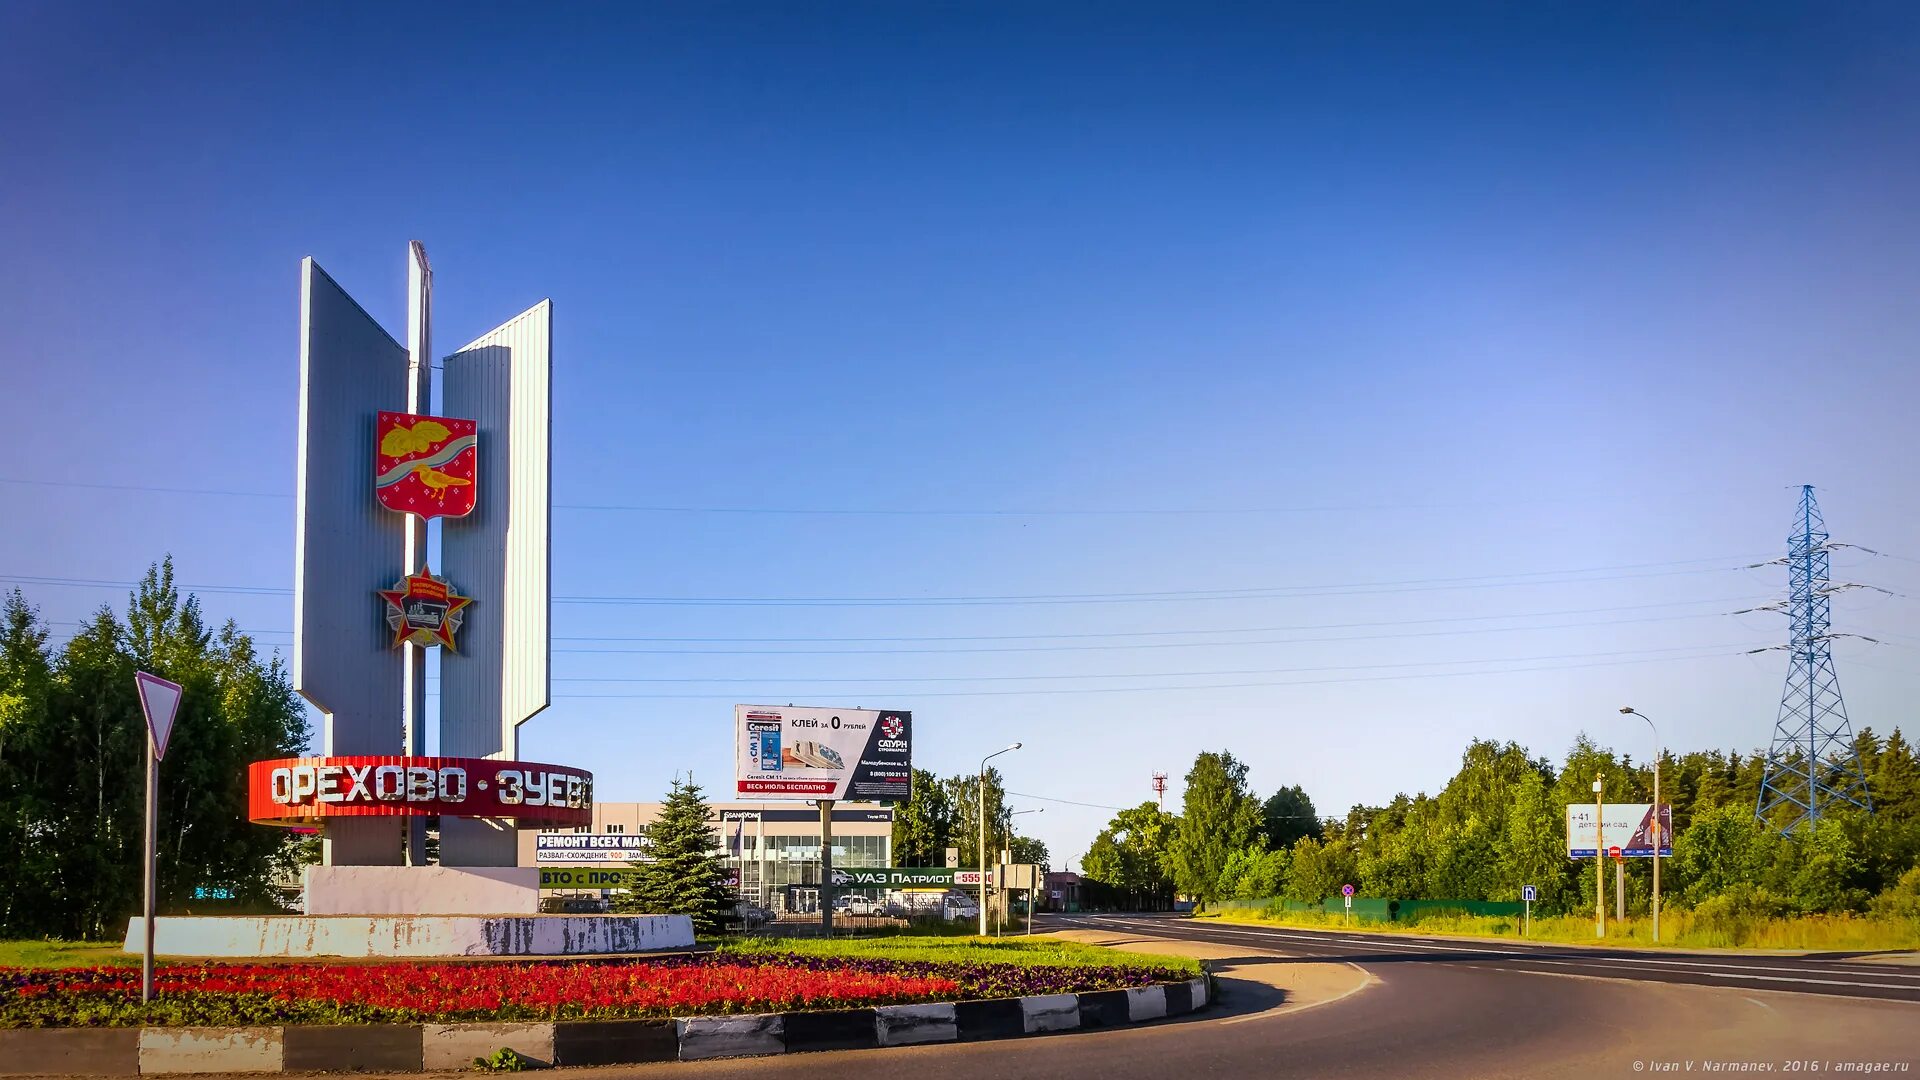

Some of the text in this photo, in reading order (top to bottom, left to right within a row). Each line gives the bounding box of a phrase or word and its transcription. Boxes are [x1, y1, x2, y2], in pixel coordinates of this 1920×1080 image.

[748, 723, 780, 732] Ceresit
[791, 718, 818, 728] КЛЕЙ
[831, 716, 841, 729] 0
[878, 739, 908, 748] САТУРН
[271, 765, 467, 805] ОРЕХОВО
[1578, 821, 1612, 829] детсий
[538, 837, 587, 847] РЕМОНТ
[591, 837, 620, 848] ВСЕХ
[540, 872, 572, 884] ВТО
[856, 874, 887, 884] УАЗ
